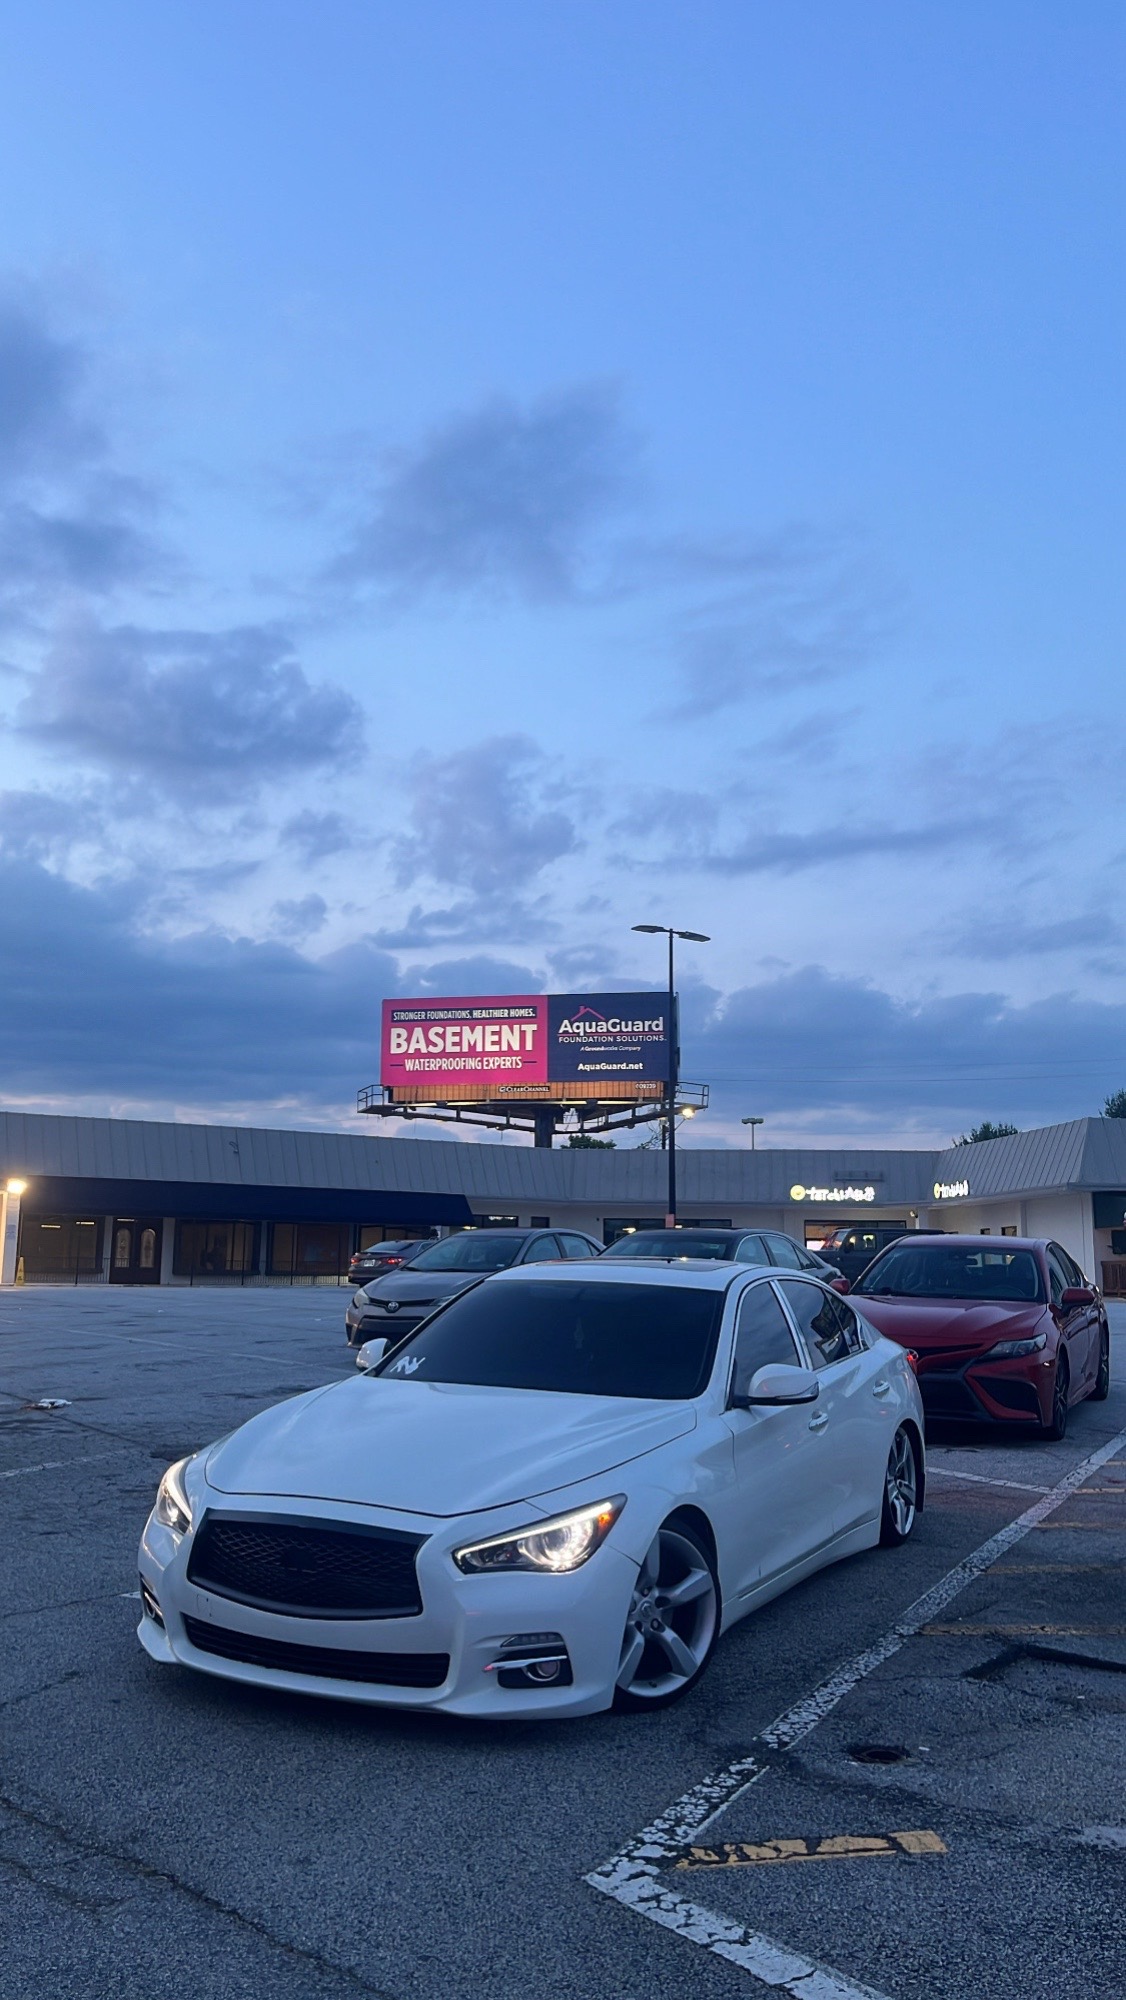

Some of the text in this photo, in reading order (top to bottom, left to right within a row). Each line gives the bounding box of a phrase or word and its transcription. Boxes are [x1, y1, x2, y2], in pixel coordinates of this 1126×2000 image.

[393, 1011, 426, 1020] STRONGER
[473, 1009, 509, 1018] HEALTHIER
[558, 1016, 664, 1036] AquaGuard
[390, 1024, 538, 1054] BASEMENT
[405, 1056, 522, 1071] WATERPROOFING EXPERTS
[577, 1062, 644, 1071] AquaGuard.net
